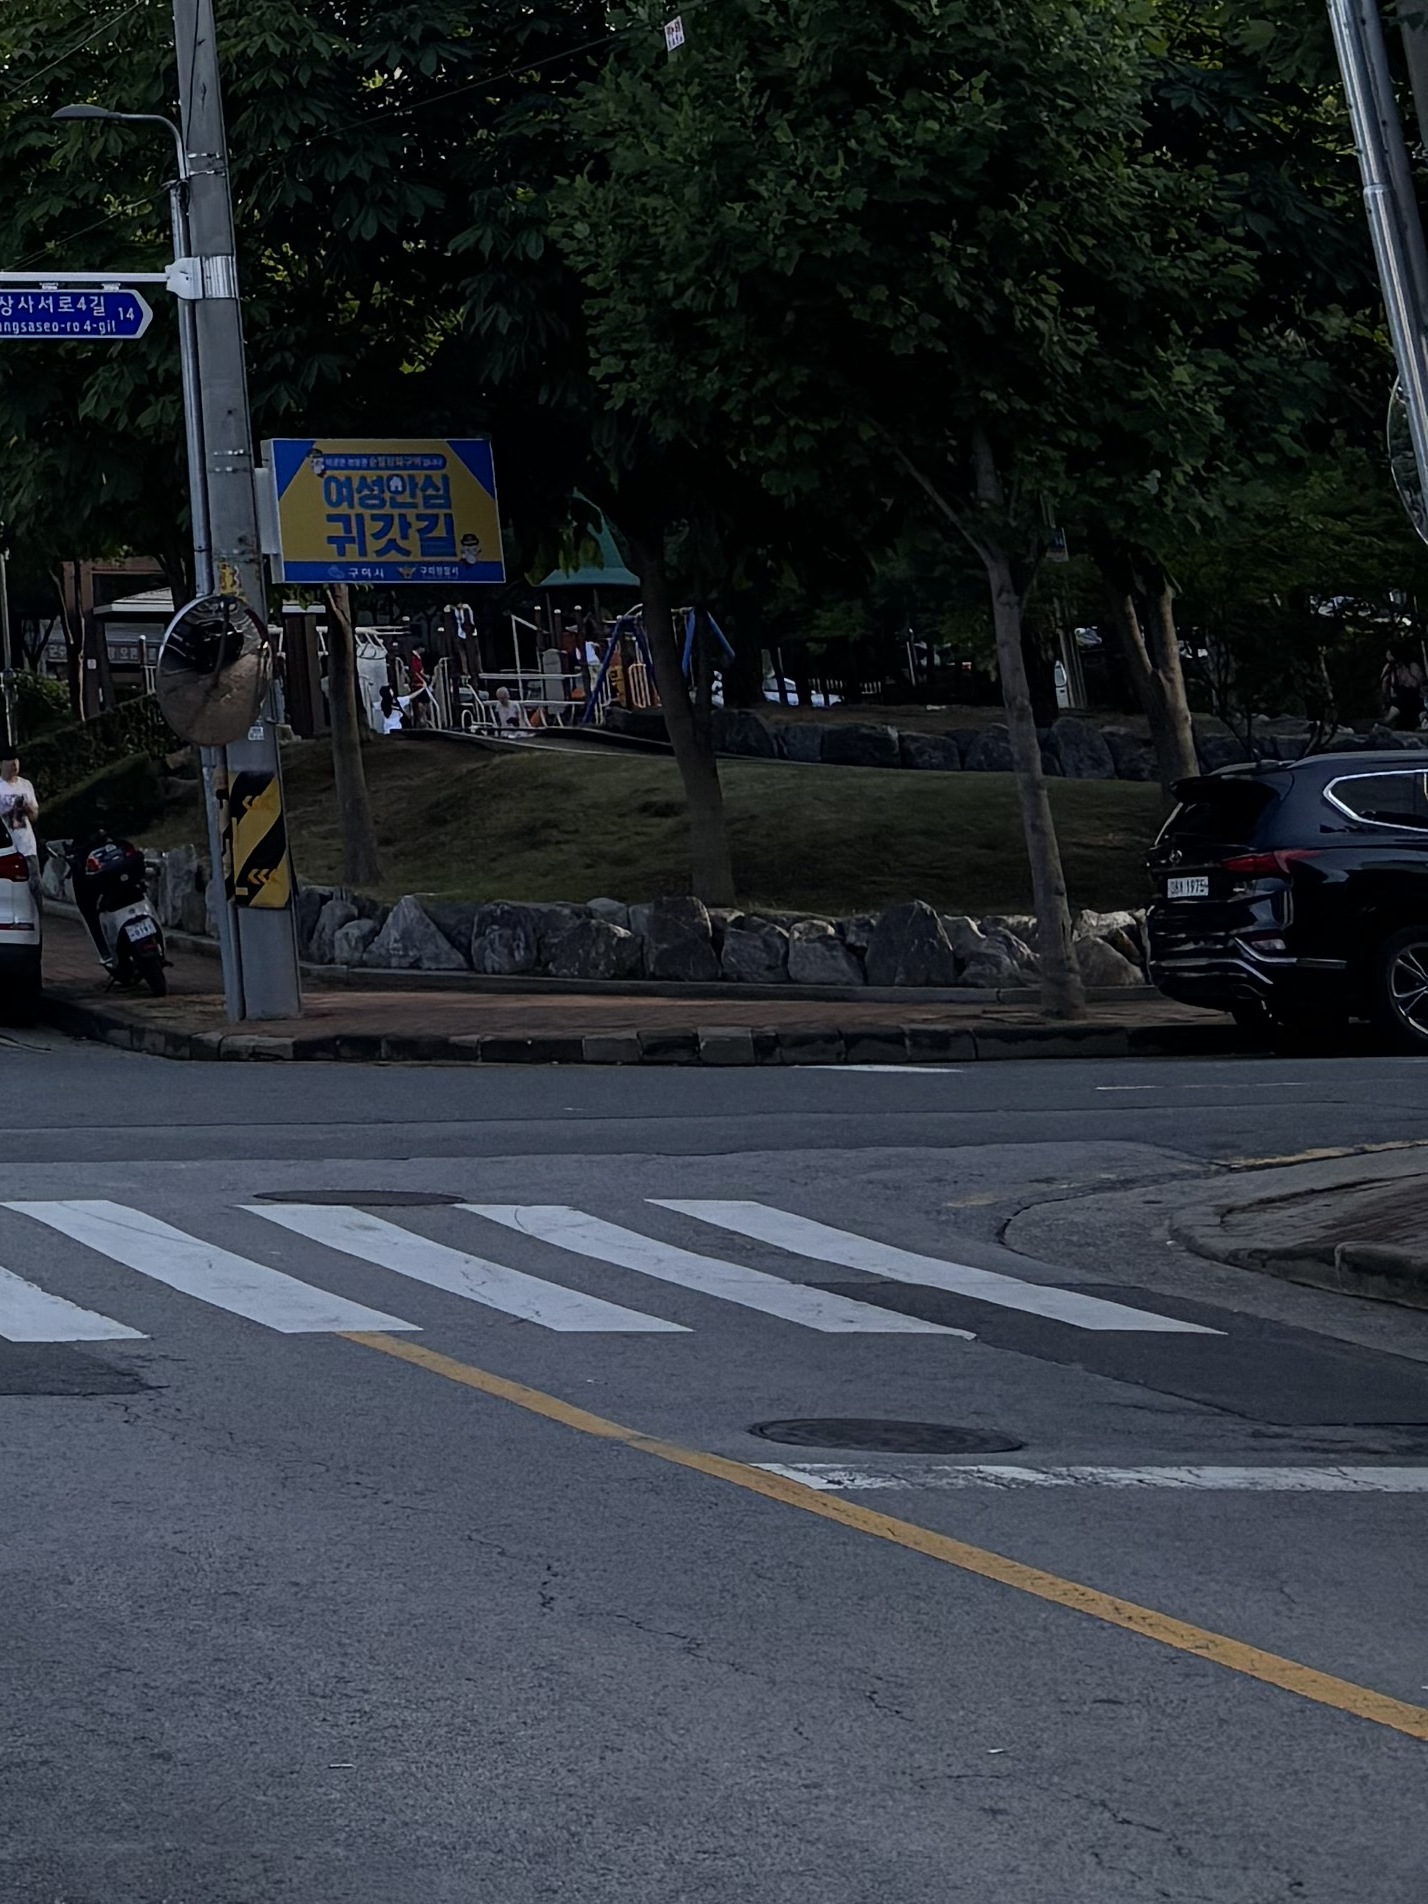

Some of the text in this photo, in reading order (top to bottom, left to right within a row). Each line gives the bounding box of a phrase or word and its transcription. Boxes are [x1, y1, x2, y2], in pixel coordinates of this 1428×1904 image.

[118, 307, 135, 321] 14
[83, 319, 116, 335] 4-gil
[323, 473, 452, 510] 여성안심
